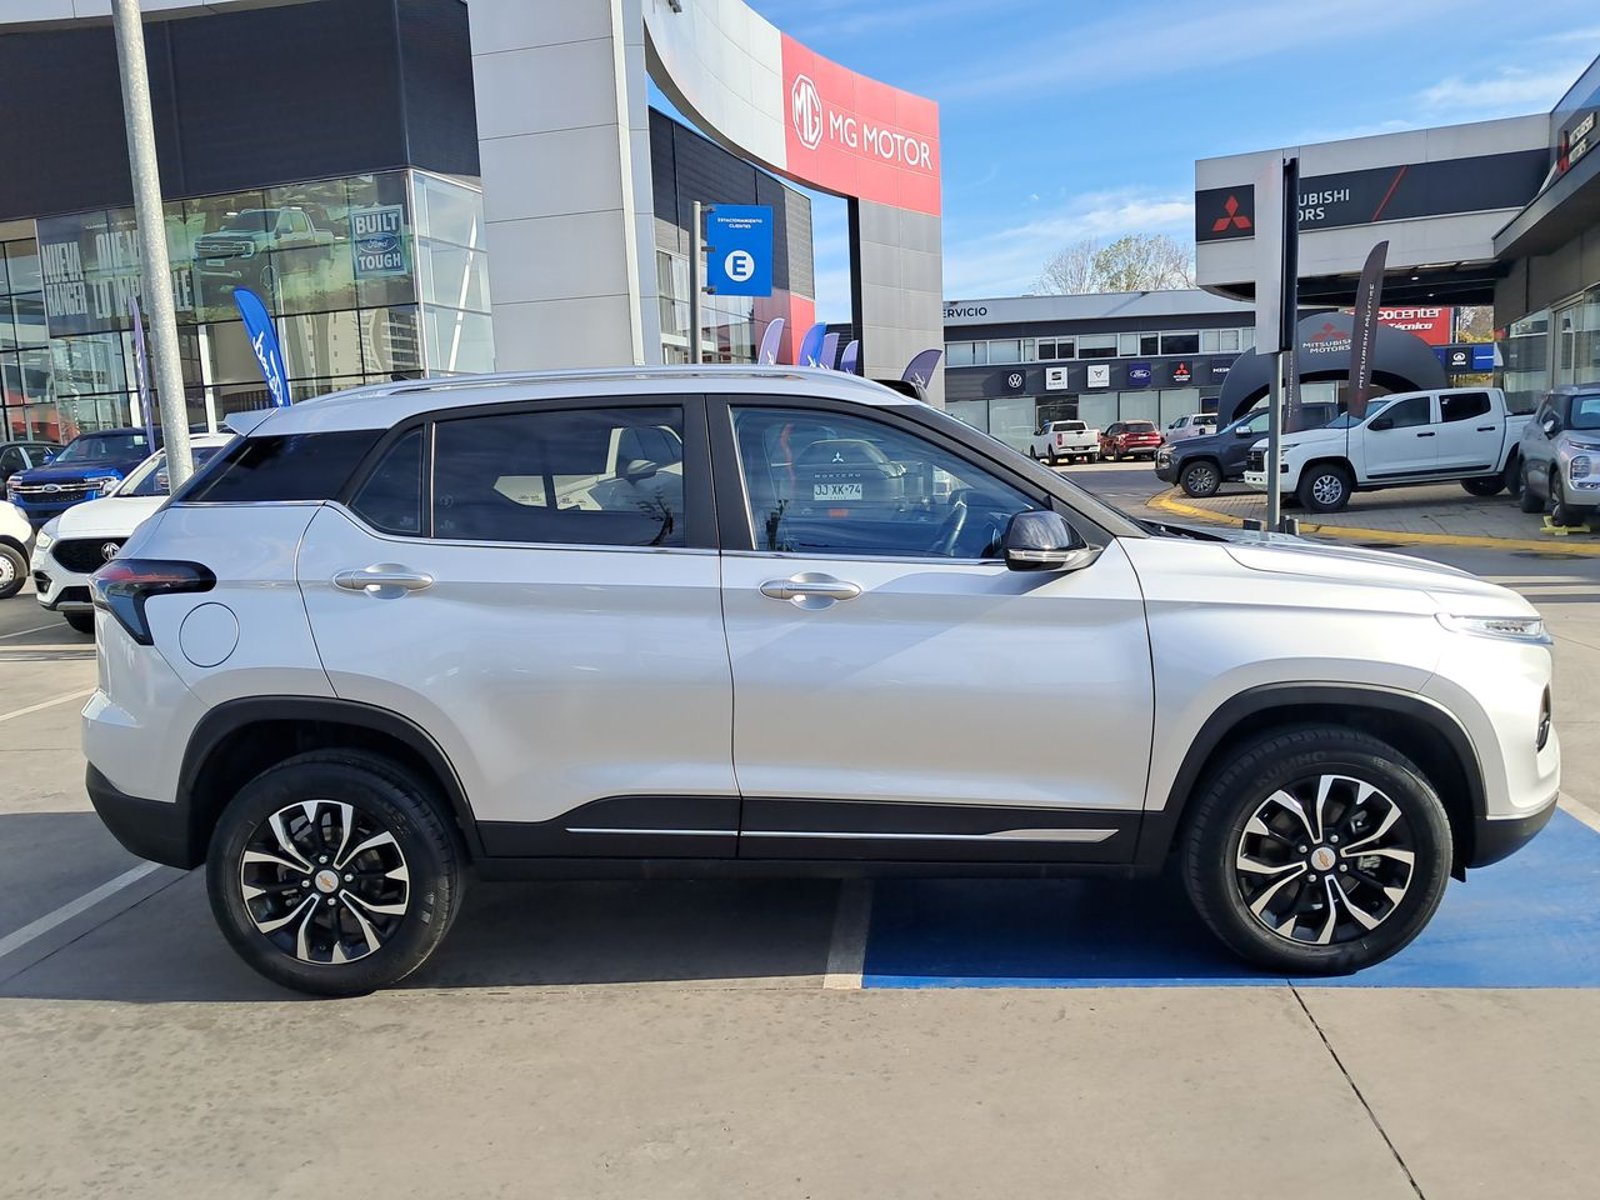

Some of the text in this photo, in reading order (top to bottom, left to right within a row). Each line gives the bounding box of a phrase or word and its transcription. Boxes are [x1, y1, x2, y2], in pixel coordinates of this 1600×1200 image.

[829, 110, 933, 170] MG MOTOR
[355, 213, 399, 234] BUILT
[41, 241, 85, 284] NUEVA
[359, 253, 402, 271] TOUGH
[732, 255, 747, 276] E
[45, 281, 88, 318] RANGER
